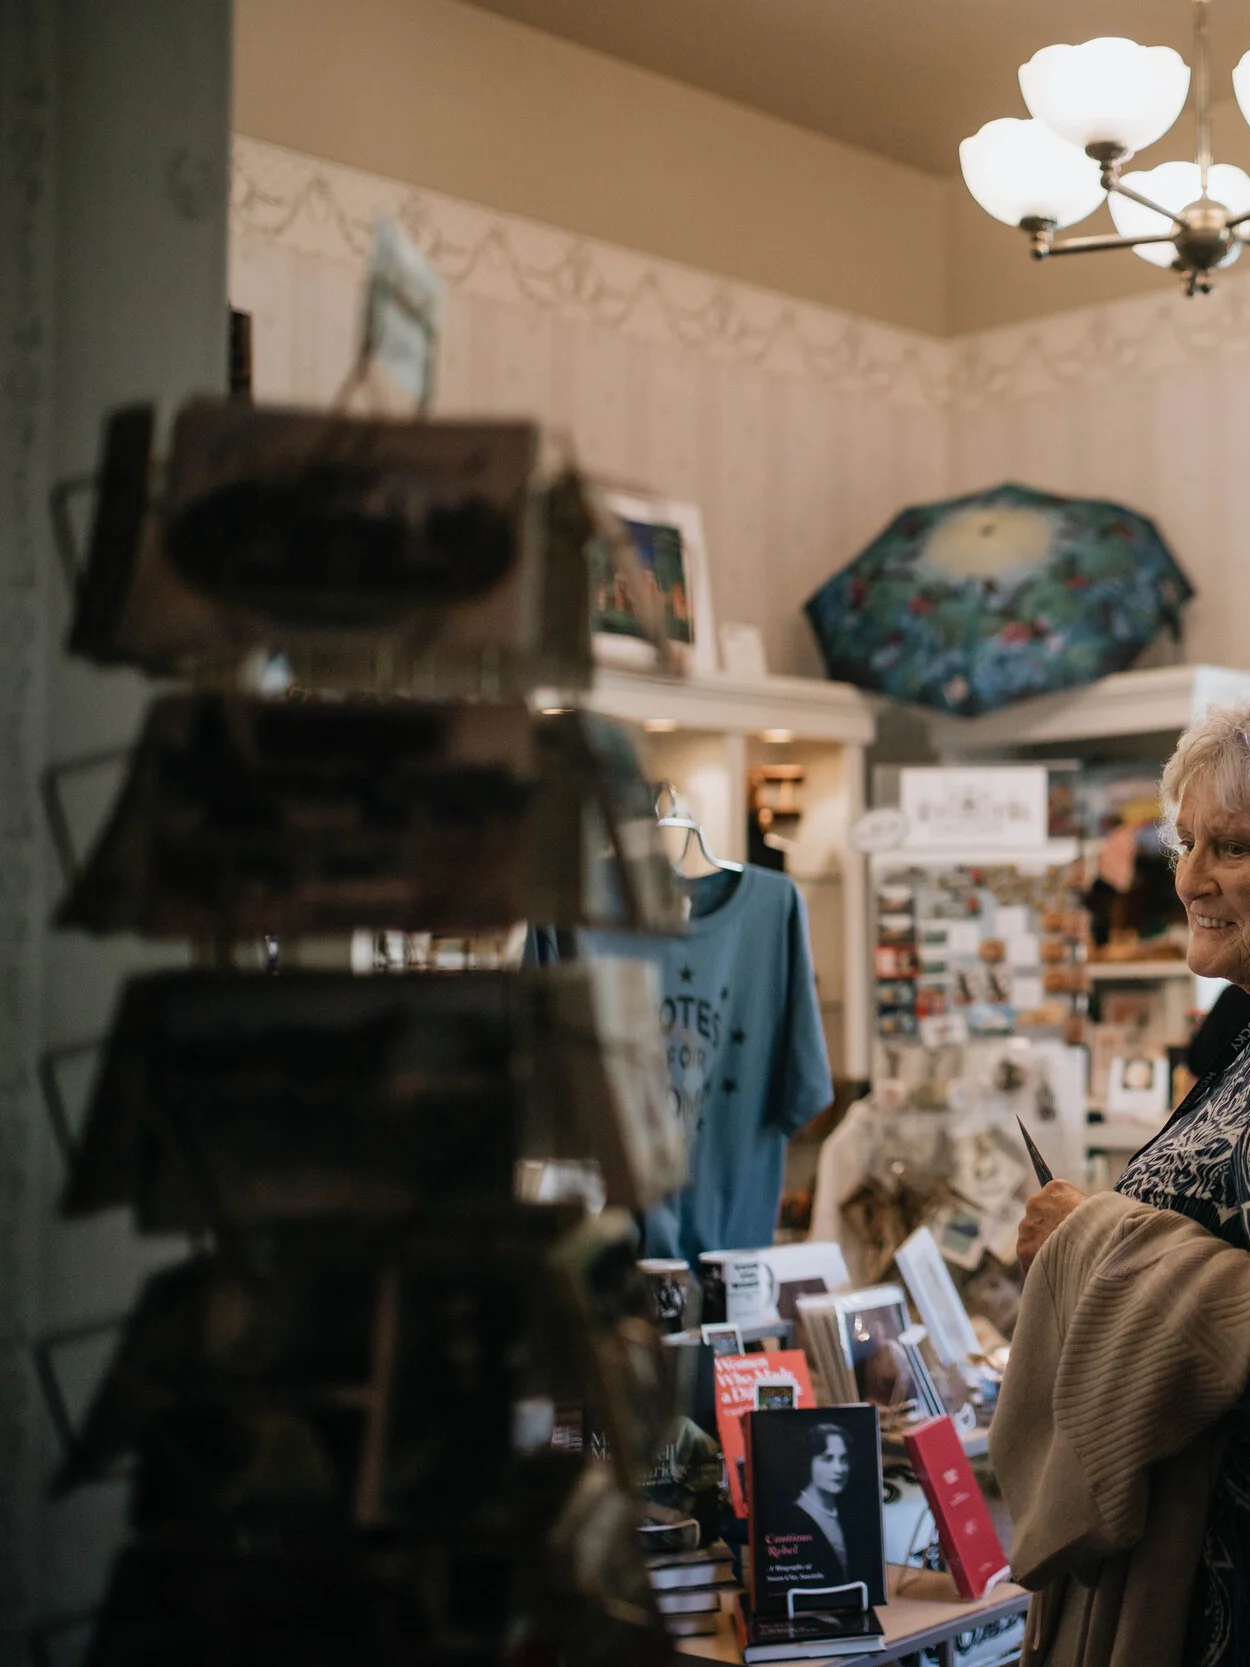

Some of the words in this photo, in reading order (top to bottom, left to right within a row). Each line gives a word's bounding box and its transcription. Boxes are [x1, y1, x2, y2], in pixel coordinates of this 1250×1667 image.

[659, 995, 719, 1049] OTES
[714, 1357, 769, 1371] Women
[717, 1372, 754, 1388] Who
[768, 1544, 799, 1558] Rebel
